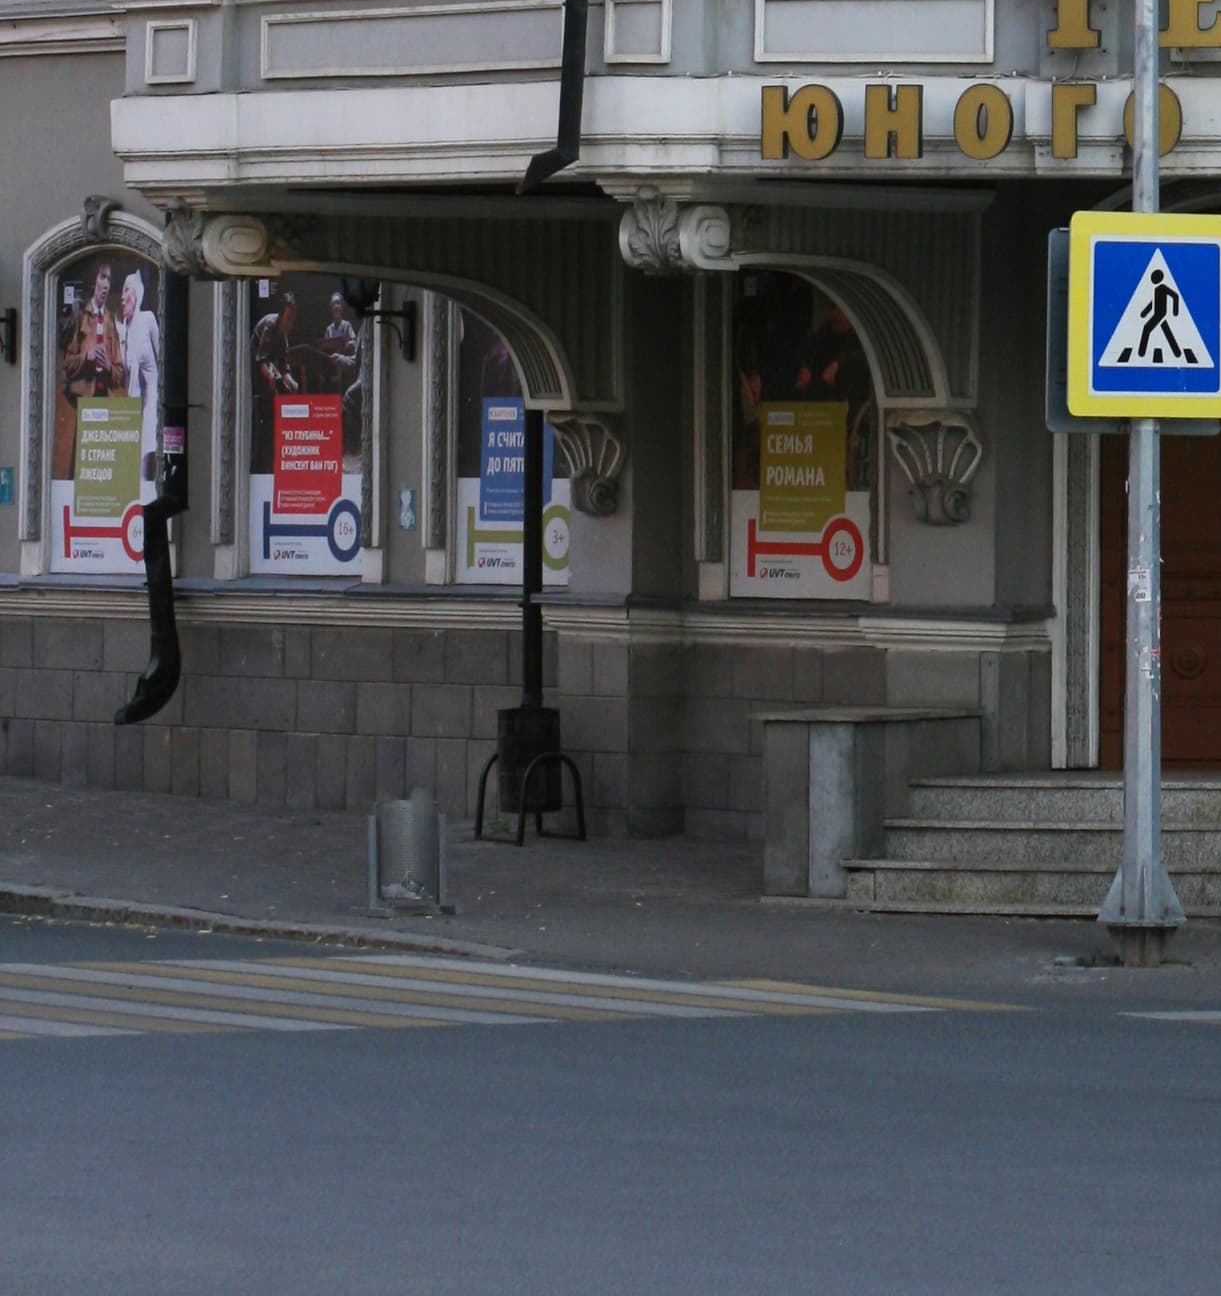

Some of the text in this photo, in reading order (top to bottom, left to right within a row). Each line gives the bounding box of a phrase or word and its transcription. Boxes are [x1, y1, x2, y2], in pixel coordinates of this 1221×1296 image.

[488, 431, 495, 448] Я
[767, 434, 813, 455] СЕМЬЯ
[486, 456, 501, 476] ДО
[766, 466, 825, 487] РОМАНА
[337, 522, 354, 536] 16+
[552, 529, 564, 544] 3+
[834, 541, 853, 556] 12+
[486, 558, 501, 568] UVT
[768, 568, 785, 579] UVT
